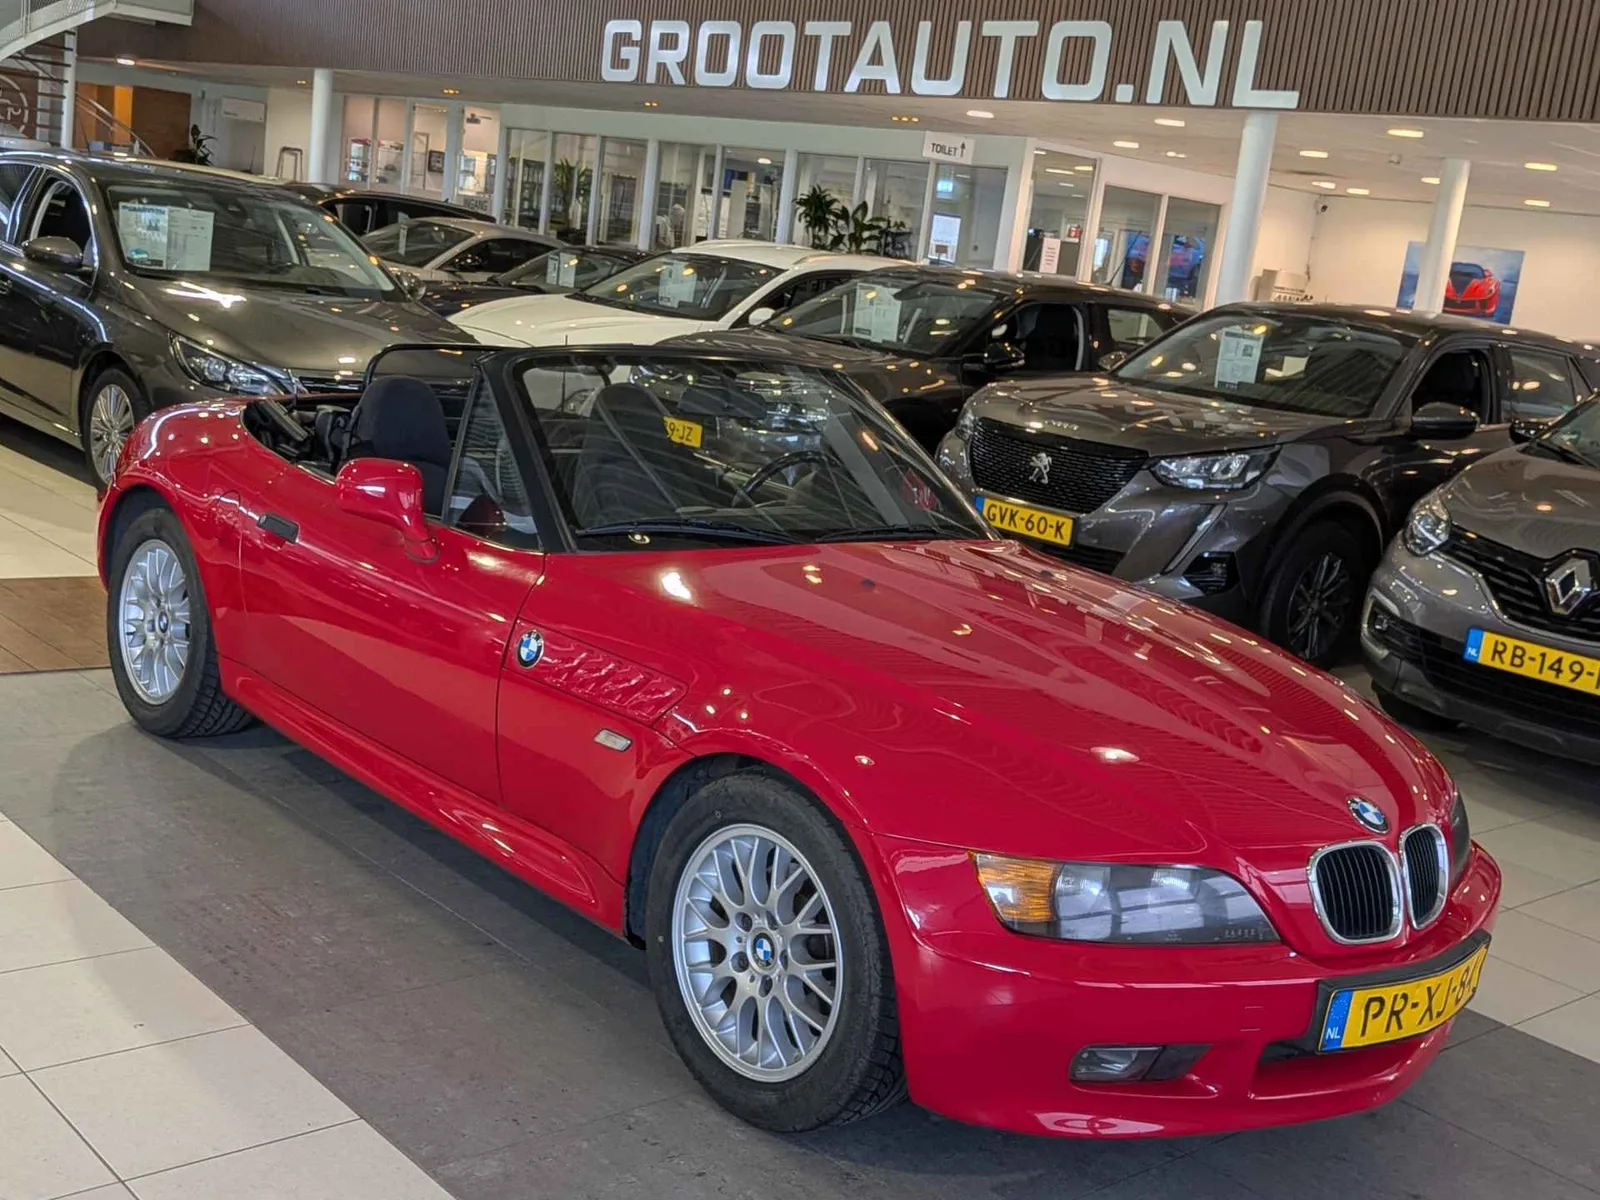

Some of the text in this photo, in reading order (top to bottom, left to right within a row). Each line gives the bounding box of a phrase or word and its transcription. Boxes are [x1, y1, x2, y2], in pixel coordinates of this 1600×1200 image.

[601, 19, 1300, 109] GROOTAUTO.NL
[931, 142, 957, 157] TOILET
[987, 503, 1066, 540] GVK-60-K
[1325, 1026, 1342, 1041] NL
